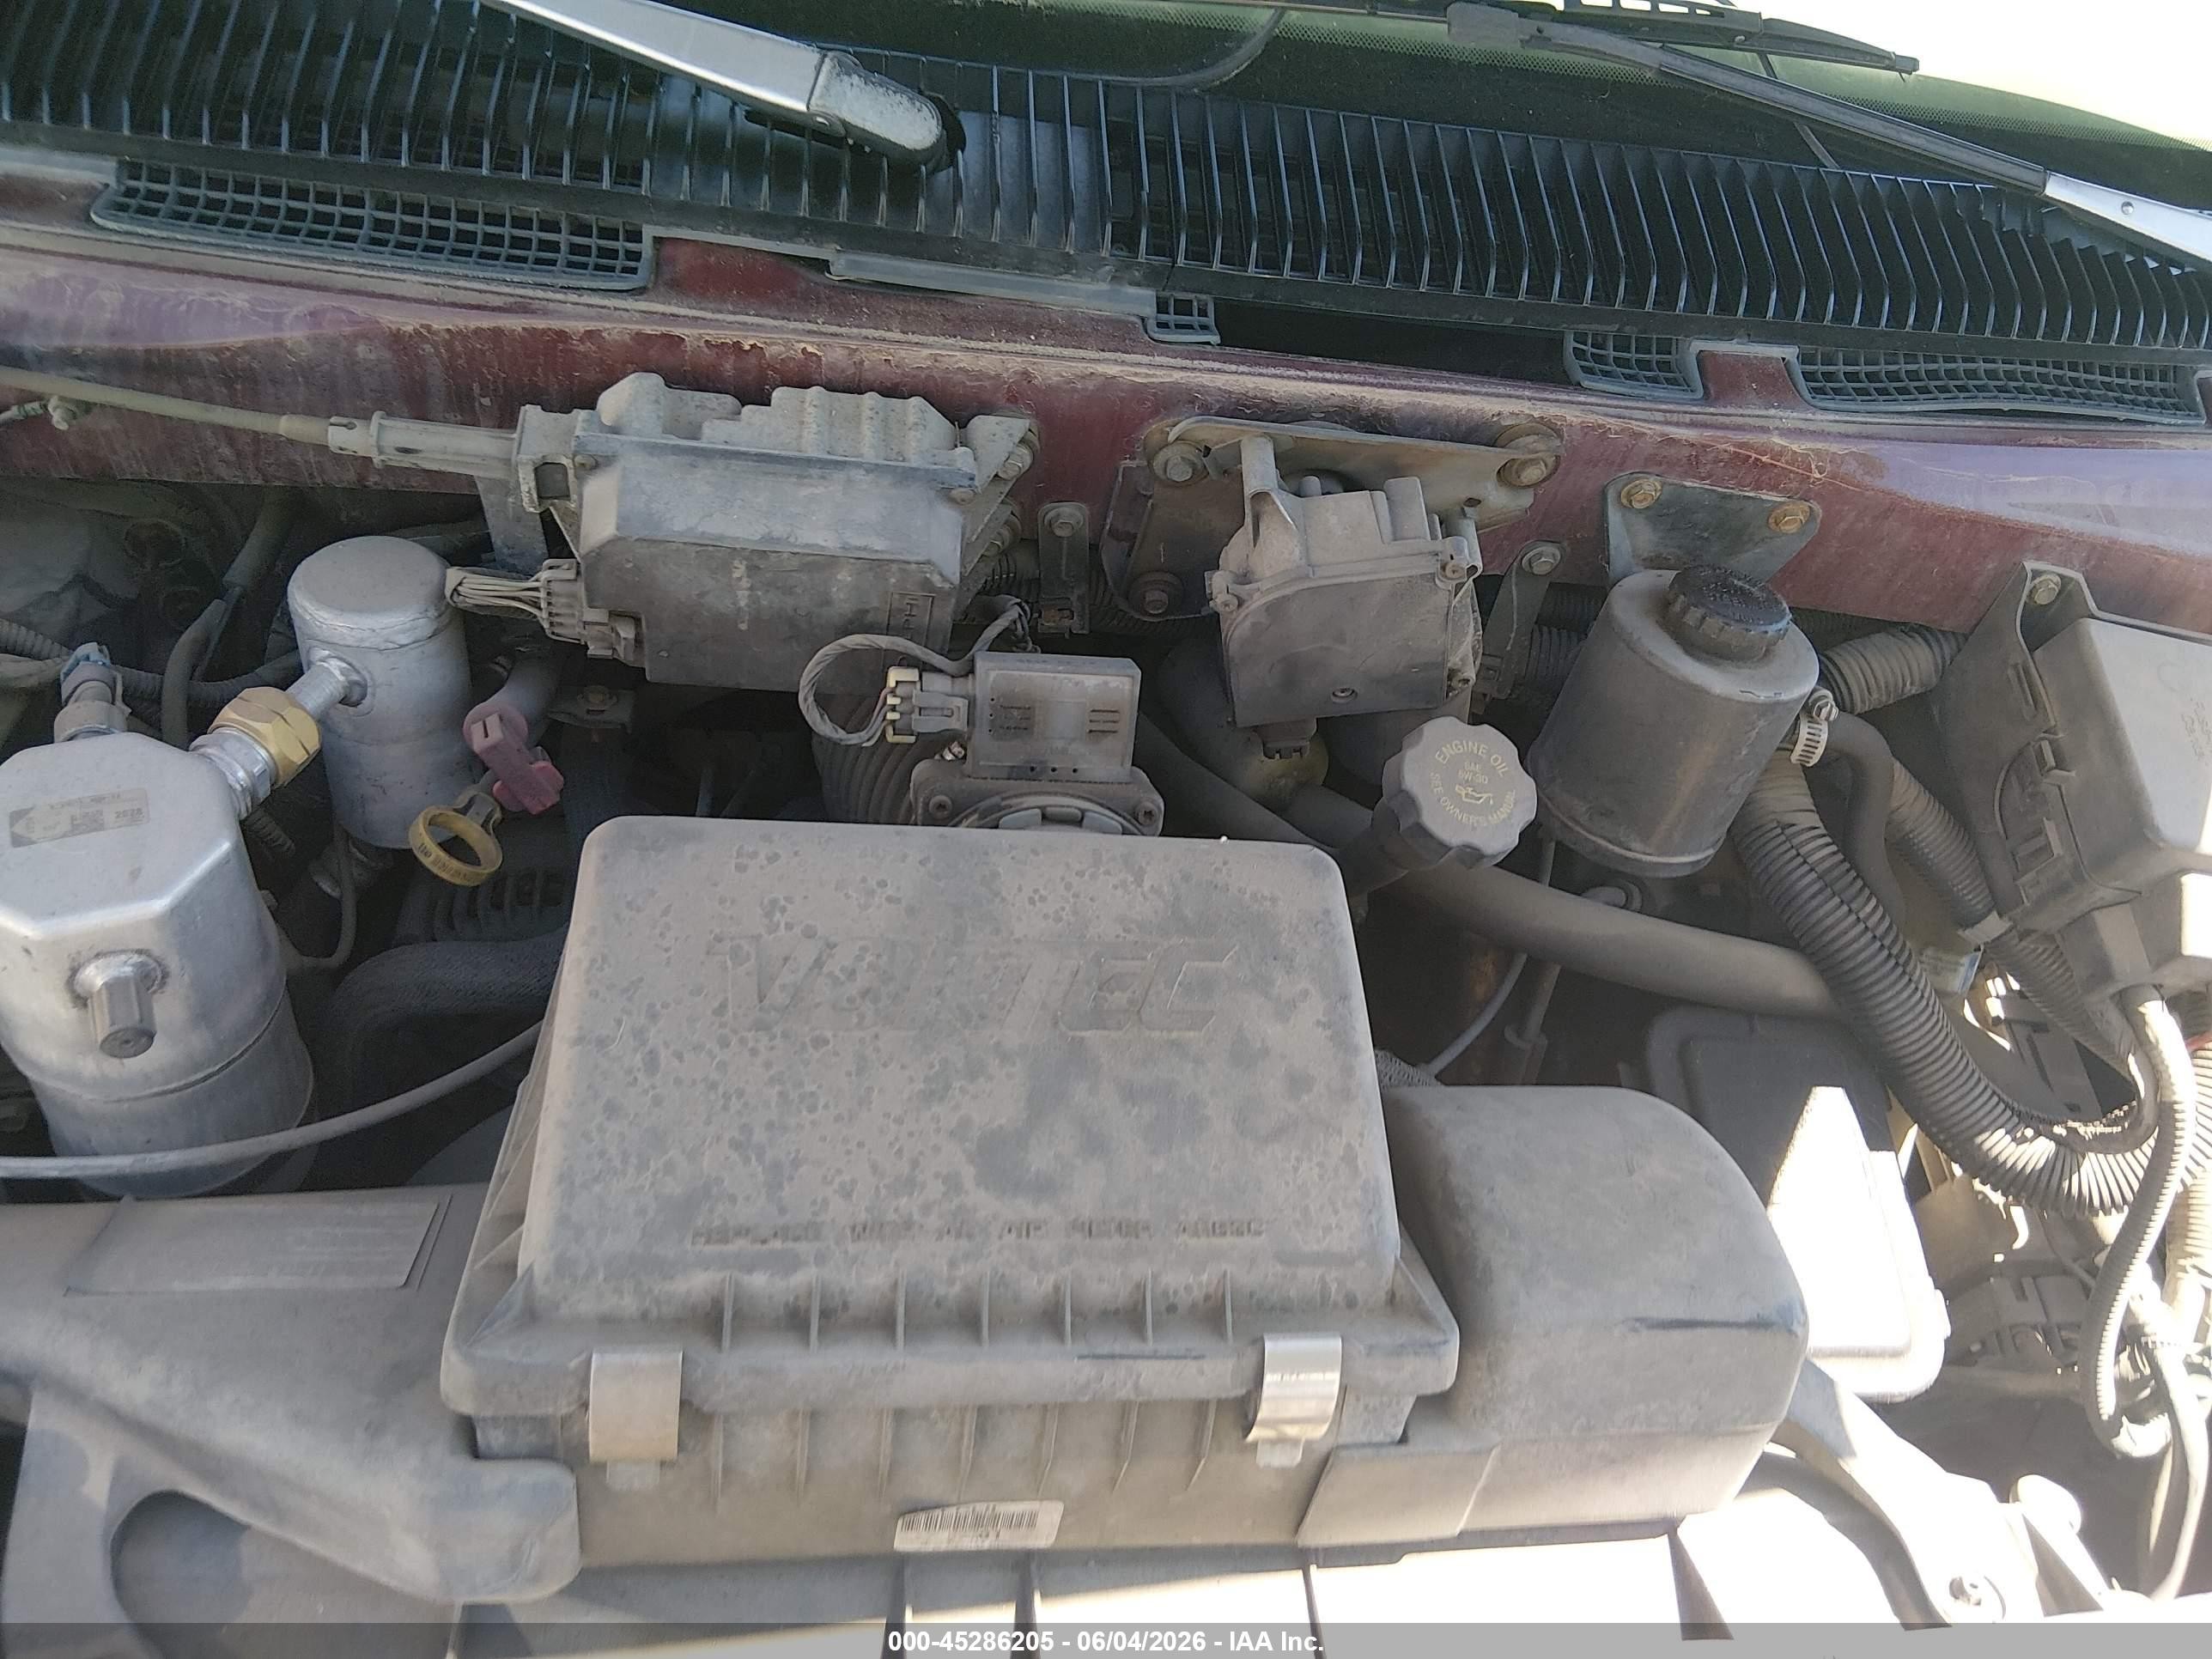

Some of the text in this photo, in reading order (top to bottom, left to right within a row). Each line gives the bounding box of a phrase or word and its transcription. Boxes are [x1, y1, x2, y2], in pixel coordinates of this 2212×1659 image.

[1435, 739, 1510, 777] ENGINE OIL
[1464, 761, 1481, 771] SAE
[1429, 772, 1444, 795] SEE
[1487, 789, 1516, 826] MANUAL
[704, 933, 1238, 1036] VTEC
